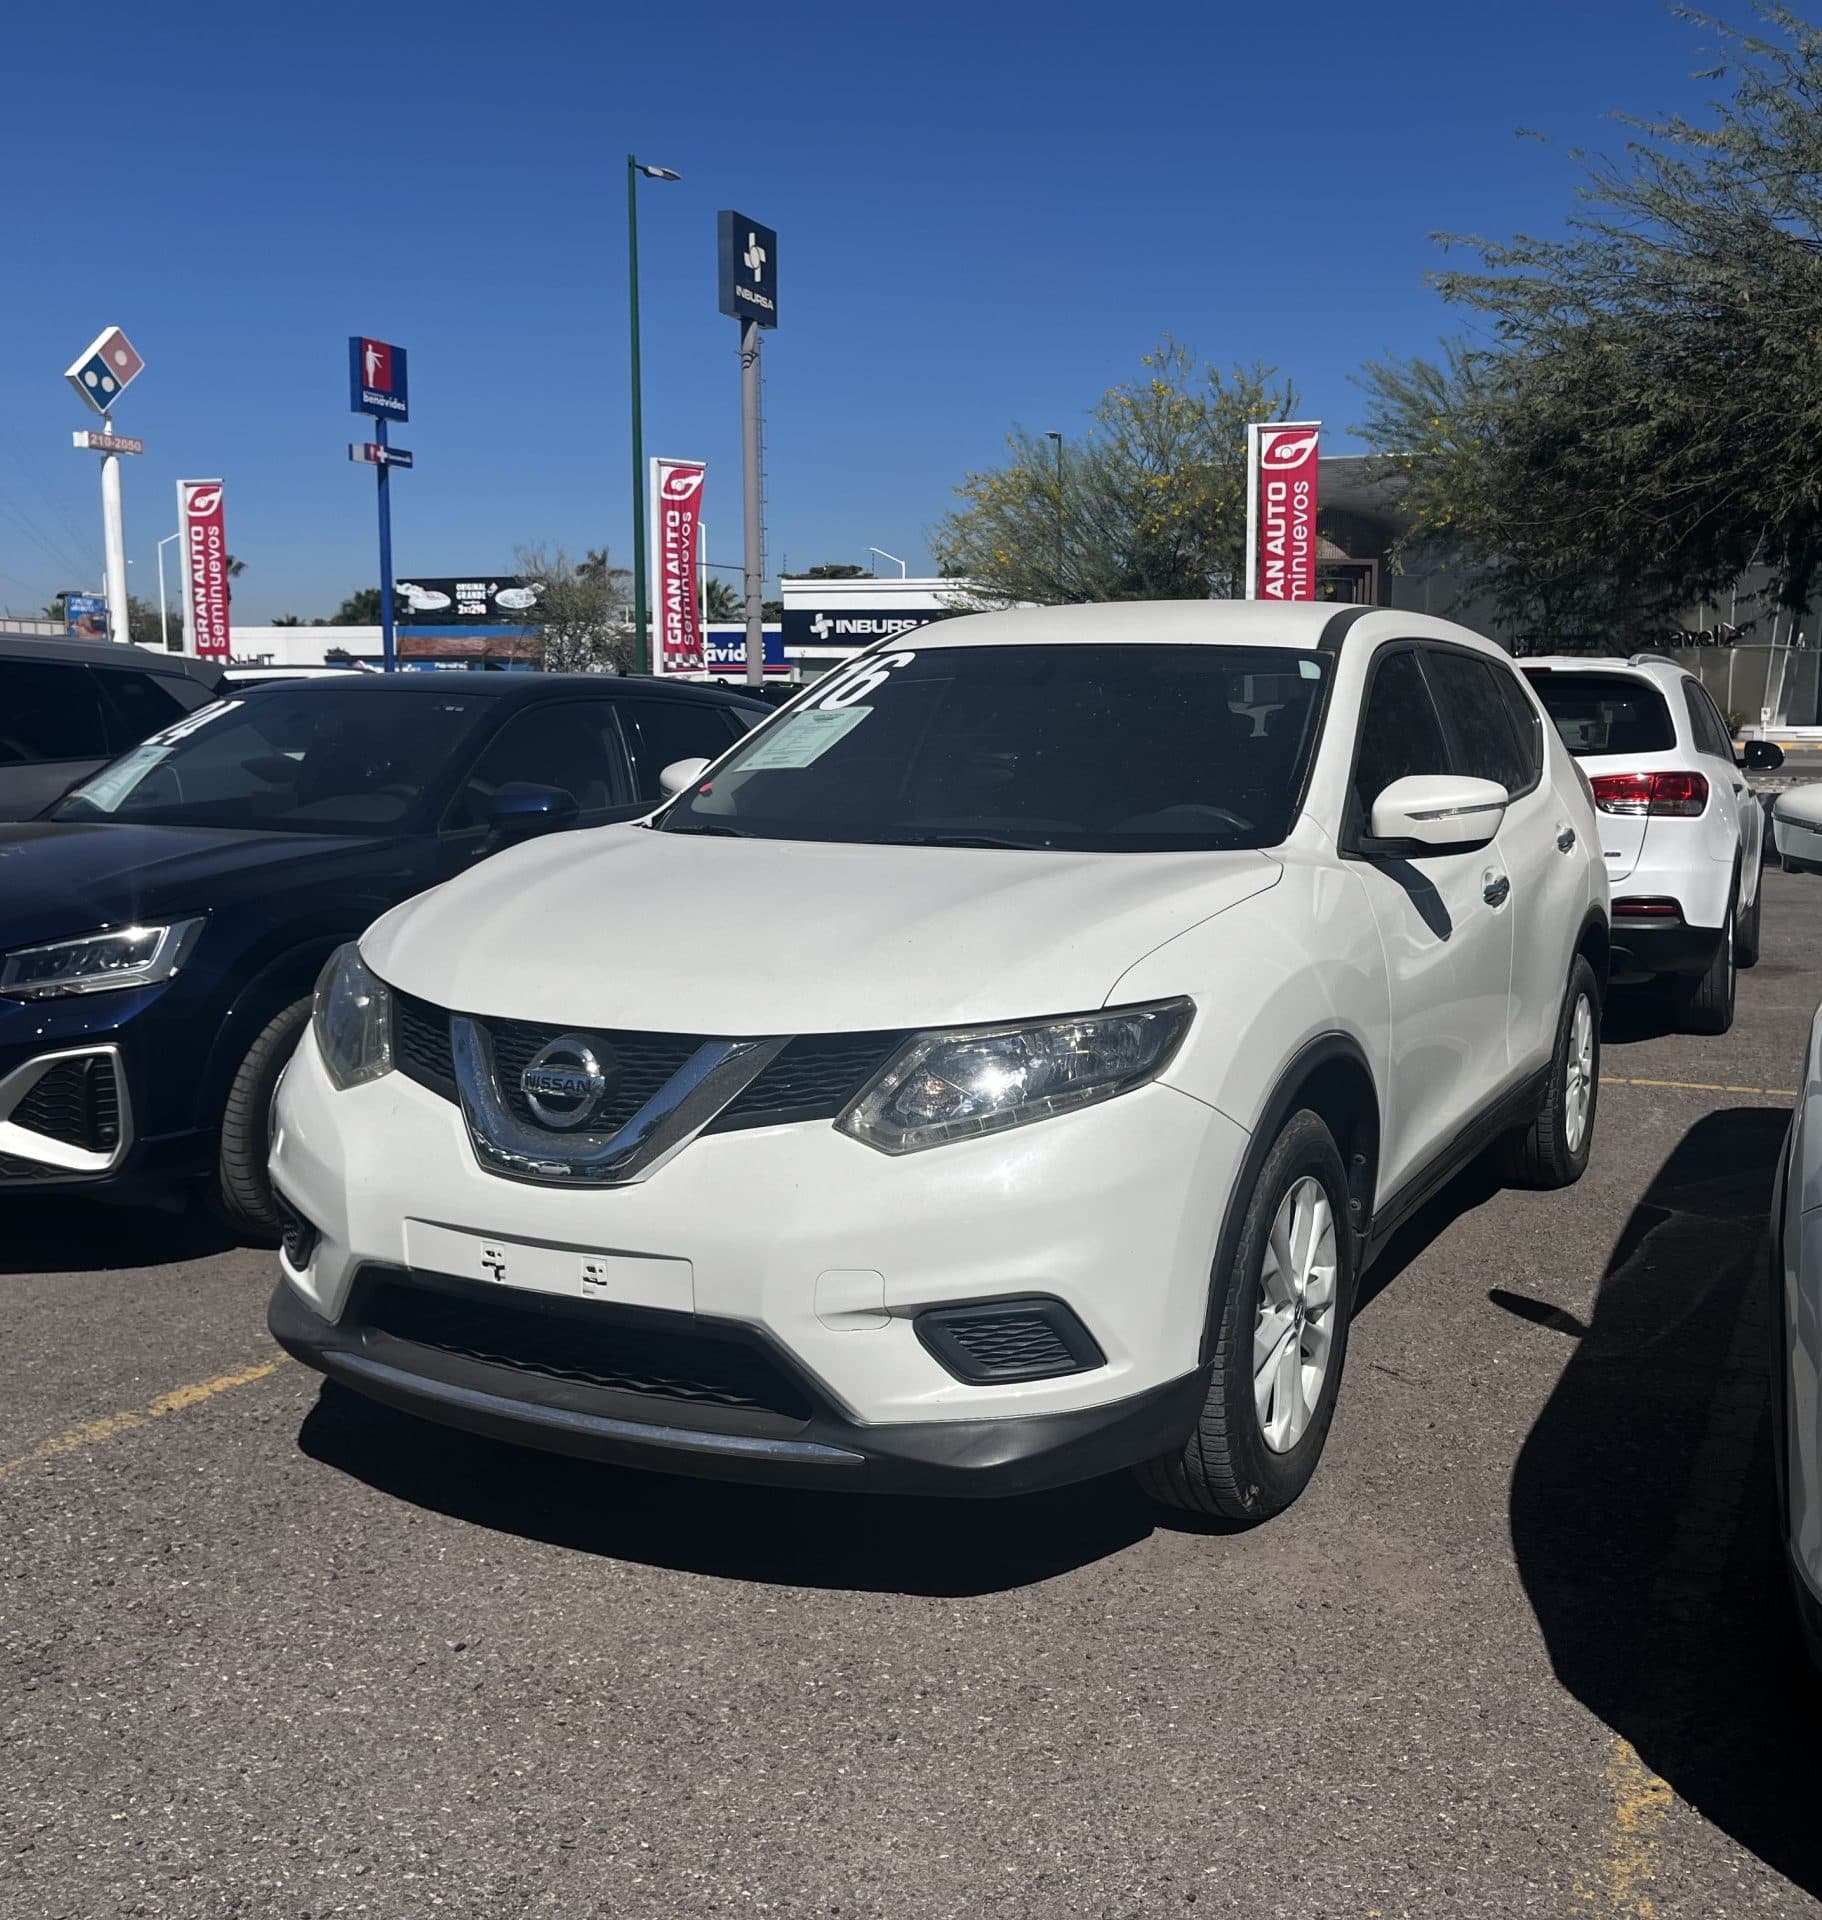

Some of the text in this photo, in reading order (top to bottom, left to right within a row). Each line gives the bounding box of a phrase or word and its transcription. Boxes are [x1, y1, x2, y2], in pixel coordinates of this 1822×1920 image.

[736, 285, 774, 311] INBURSA
[363, 390, 406, 411] benavides
[1266, 481, 1287, 556] AUTO
[191, 526, 210, 648] GRAN AUTO
[208, 525, 226, 648] Seminuevos
[456, 591, 486, 600] GRANDE
[681, 511, 695, 646] Seminuevos
[667, 579, 682, 645] GRAN
[836, 619, 929, 634] INBURS
[791, 651, 916, 713] 16
[528, 1073, 595, 1093] NISSAN
